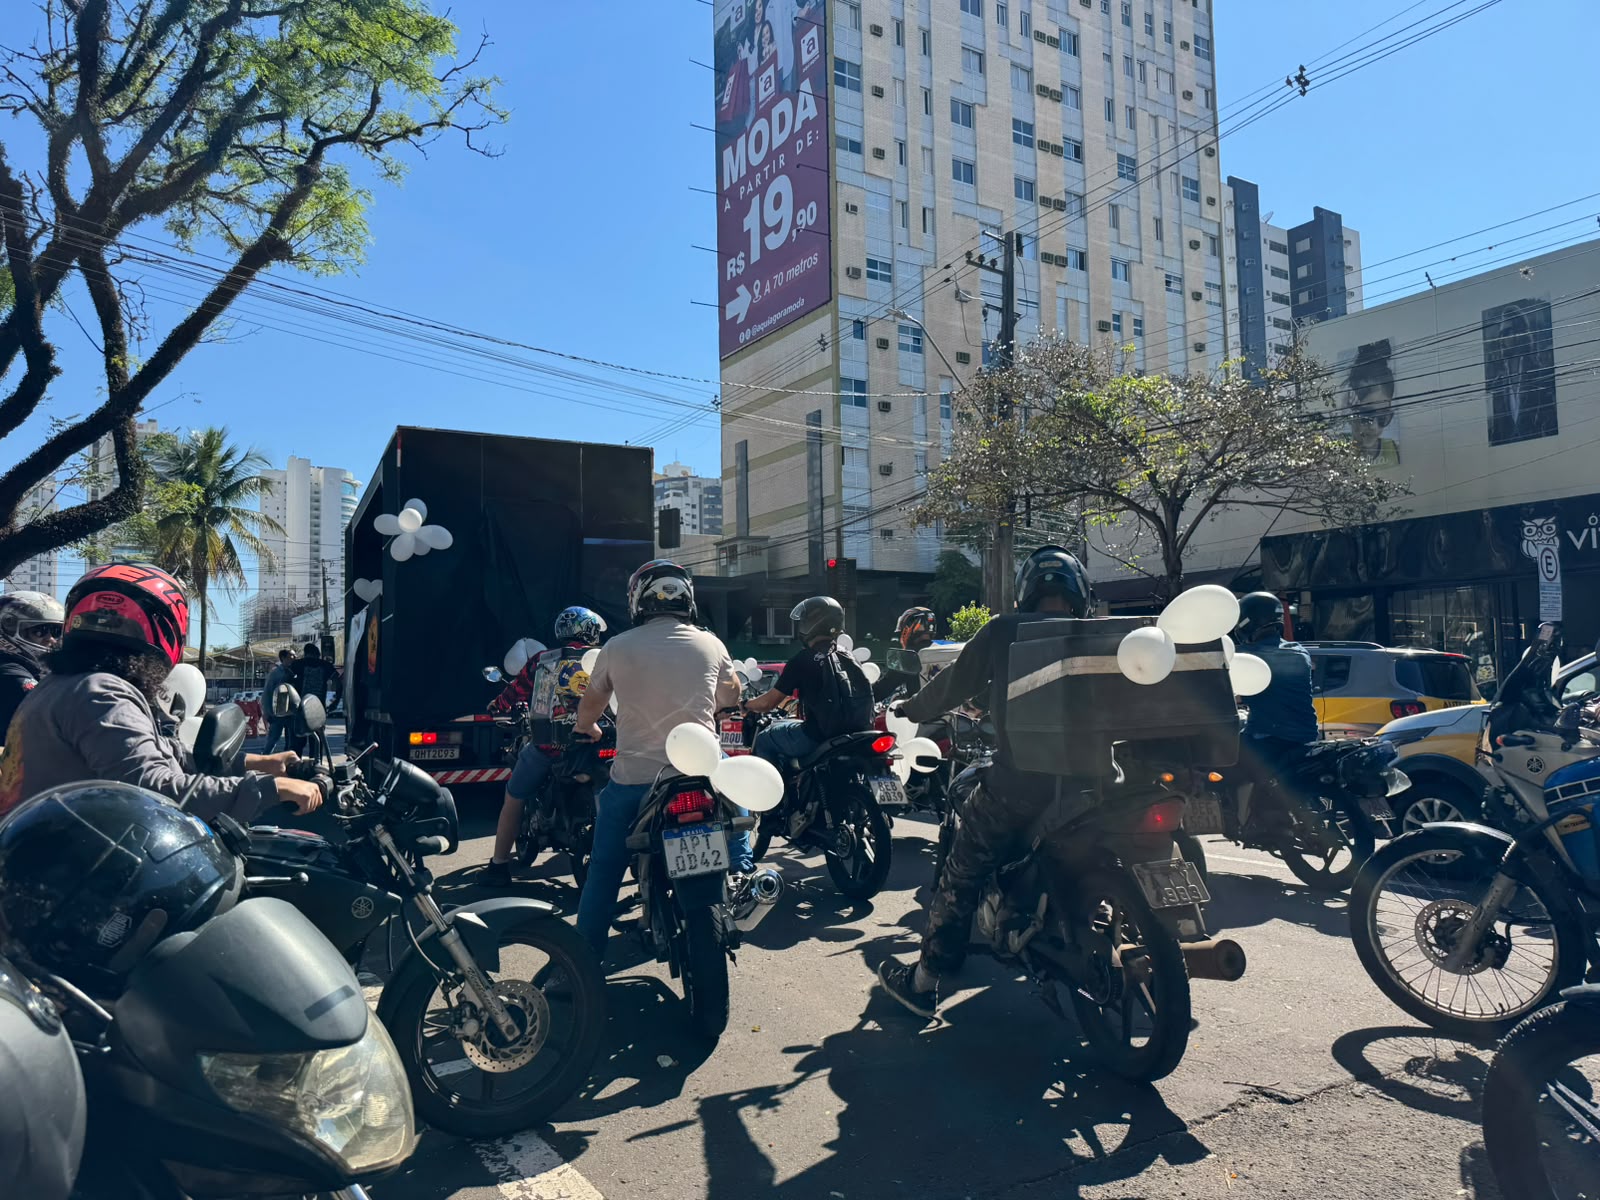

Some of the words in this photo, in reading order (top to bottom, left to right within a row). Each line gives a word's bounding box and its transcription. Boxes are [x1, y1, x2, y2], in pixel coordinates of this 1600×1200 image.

[723, 78, 818, 191] MODA
[724, 198, 731, 212] A
[739, 153, 785, 200] PARTIR
[796, 130, 819, 155] DE:
[726, 250, 745, 281] R$
[763, 281, 771, 296] A
[773, 275, 784, 289] 70
[786, 252, 818, 283] metros
[1566, 527, 1600, 550] VI
[1545, 555, 1553, 573] E
[680, 834, 712, 854] APT
[682, 828, 705, 837] BRASIL
